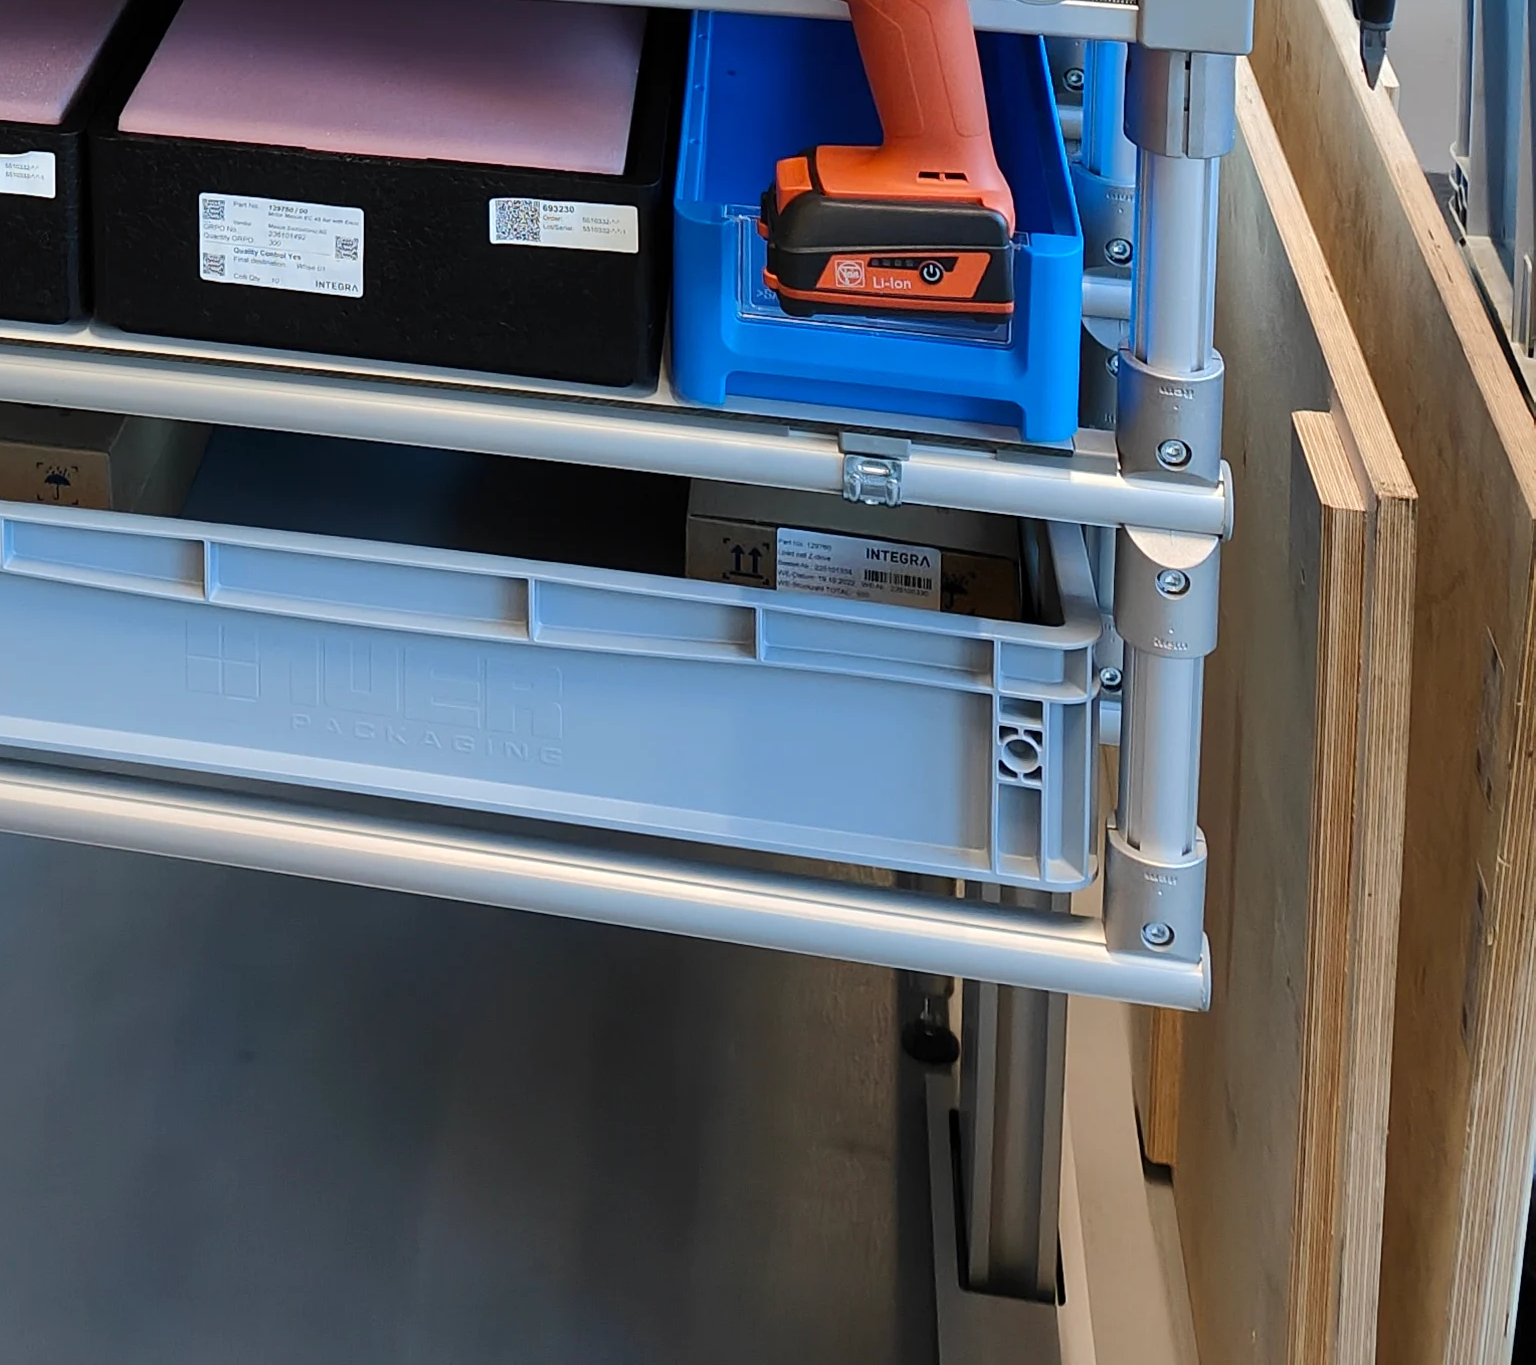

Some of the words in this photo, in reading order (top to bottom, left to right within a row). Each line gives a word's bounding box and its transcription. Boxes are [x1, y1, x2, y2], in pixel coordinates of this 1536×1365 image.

[542, 204, 575, 214] 693230
[233, 247, 258, 257] Quality
[259, 249, 286, 259] Control
[288, 253, 302, 261] Yes
[315, 280, 359, 293] INTEGRA
[866, 547, 931, 568] INTEGRA
[290, 712, 564, 766] PACKAGING
